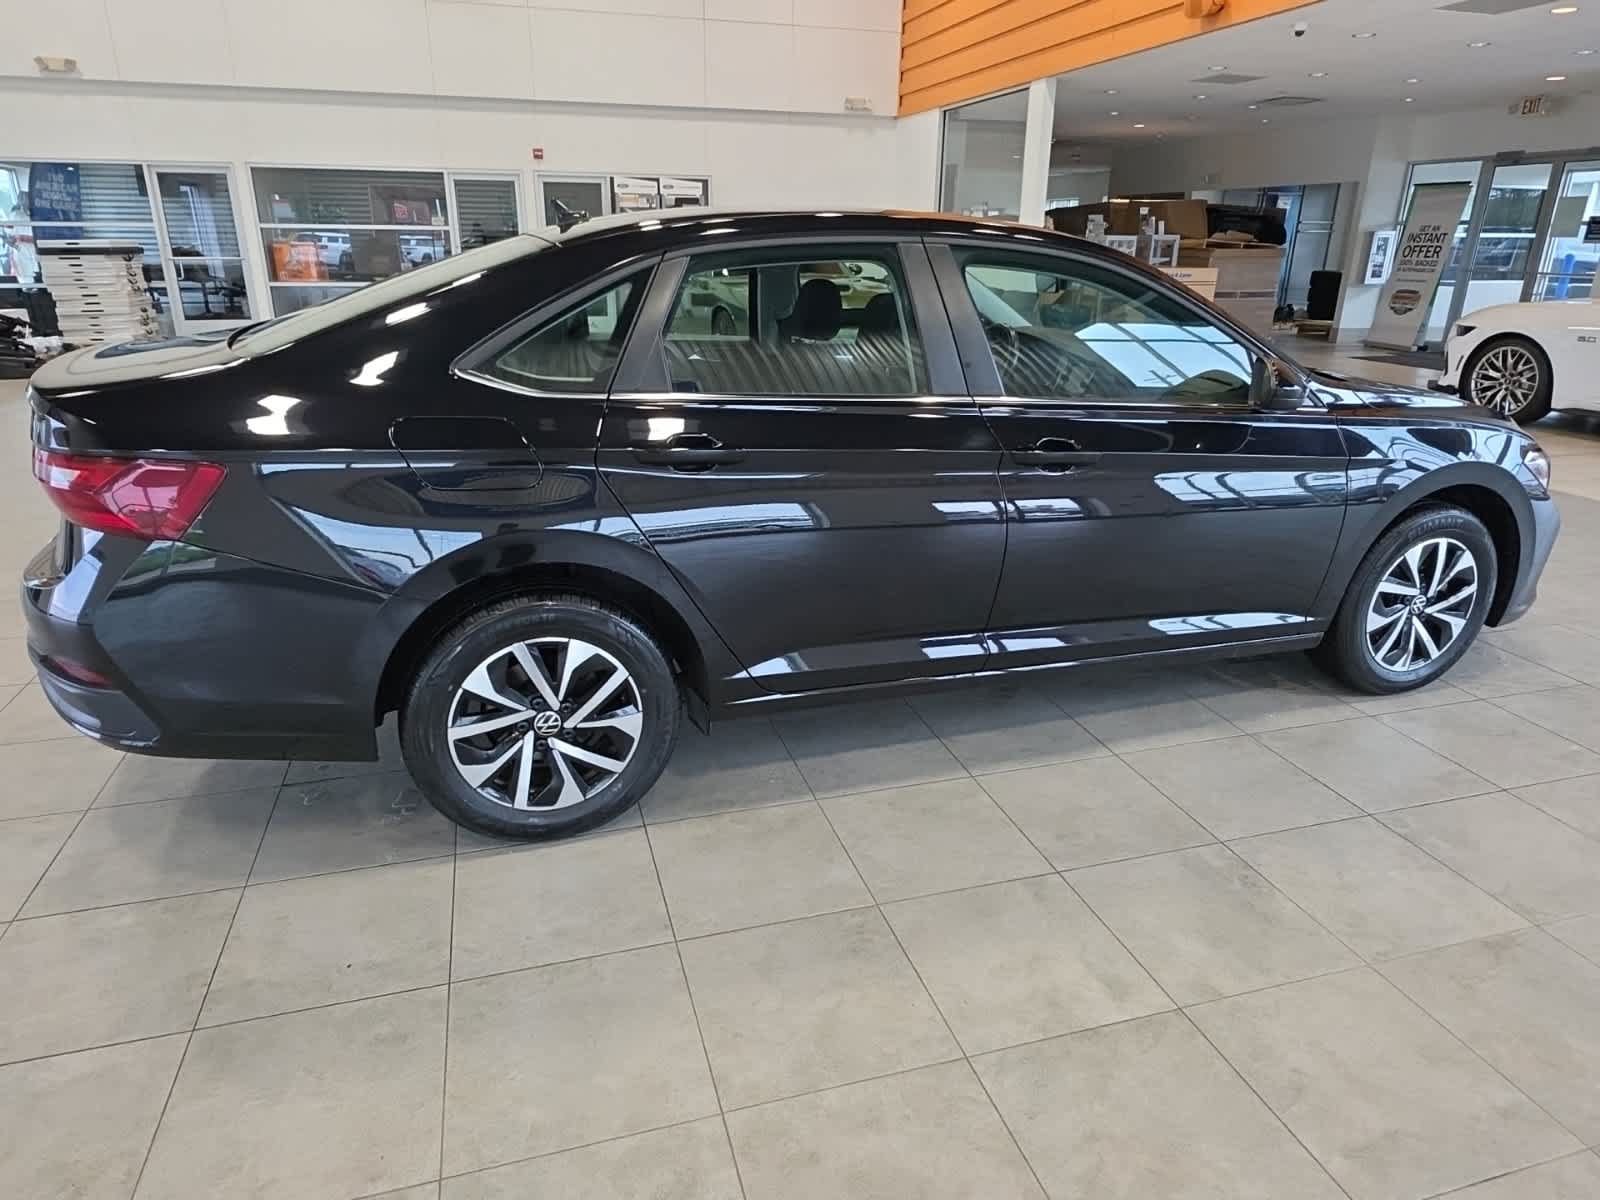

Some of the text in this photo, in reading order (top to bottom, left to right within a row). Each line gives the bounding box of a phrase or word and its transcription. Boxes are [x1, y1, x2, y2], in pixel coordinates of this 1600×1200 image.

[1521, 98, 1542, 114] EXIT
[1407, 232, 1448, 244] INSTANT
[1402, 244, 1442, 259] OFFER
